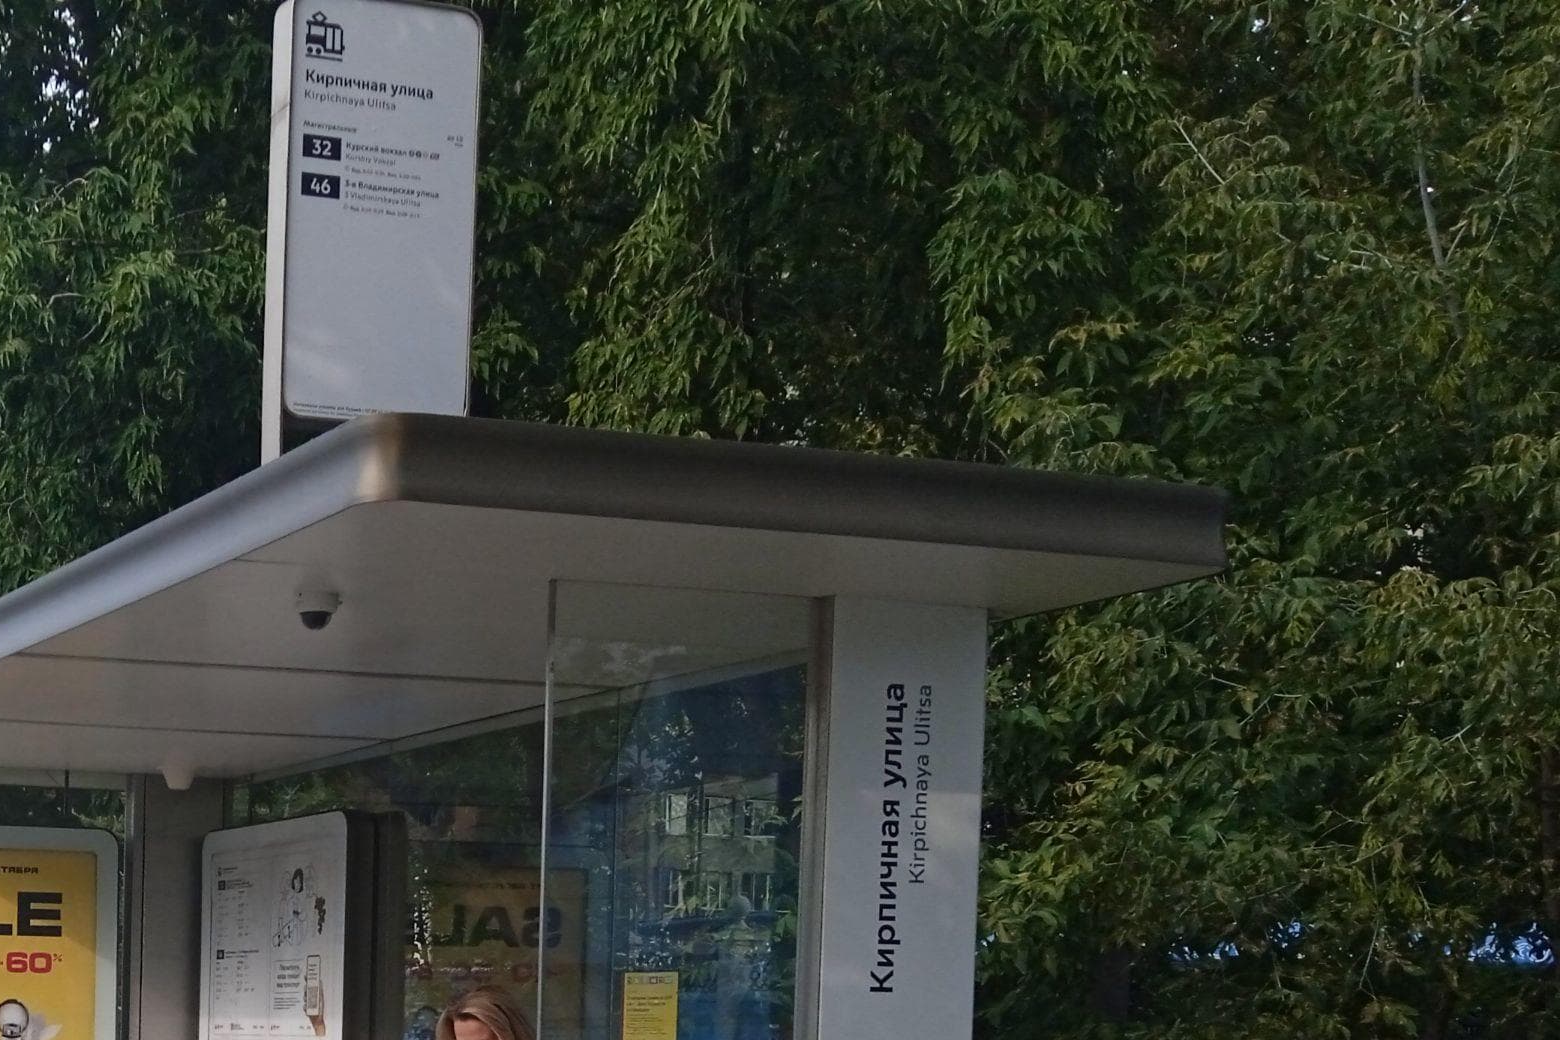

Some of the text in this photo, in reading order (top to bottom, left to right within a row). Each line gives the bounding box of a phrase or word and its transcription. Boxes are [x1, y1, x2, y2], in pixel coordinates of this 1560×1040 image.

[305, 68, 434, 101] Кирпичная улица
[304, 89, 397, 112] Kirpichnaya Ulitsa
[312, 138, 332, 156] 32
[310, 177, 331, 194] 46
[909, 684, 932, 884] Kirpichnaya Ulitsa
[870, 682, 907, 993] Кирпичная улица
